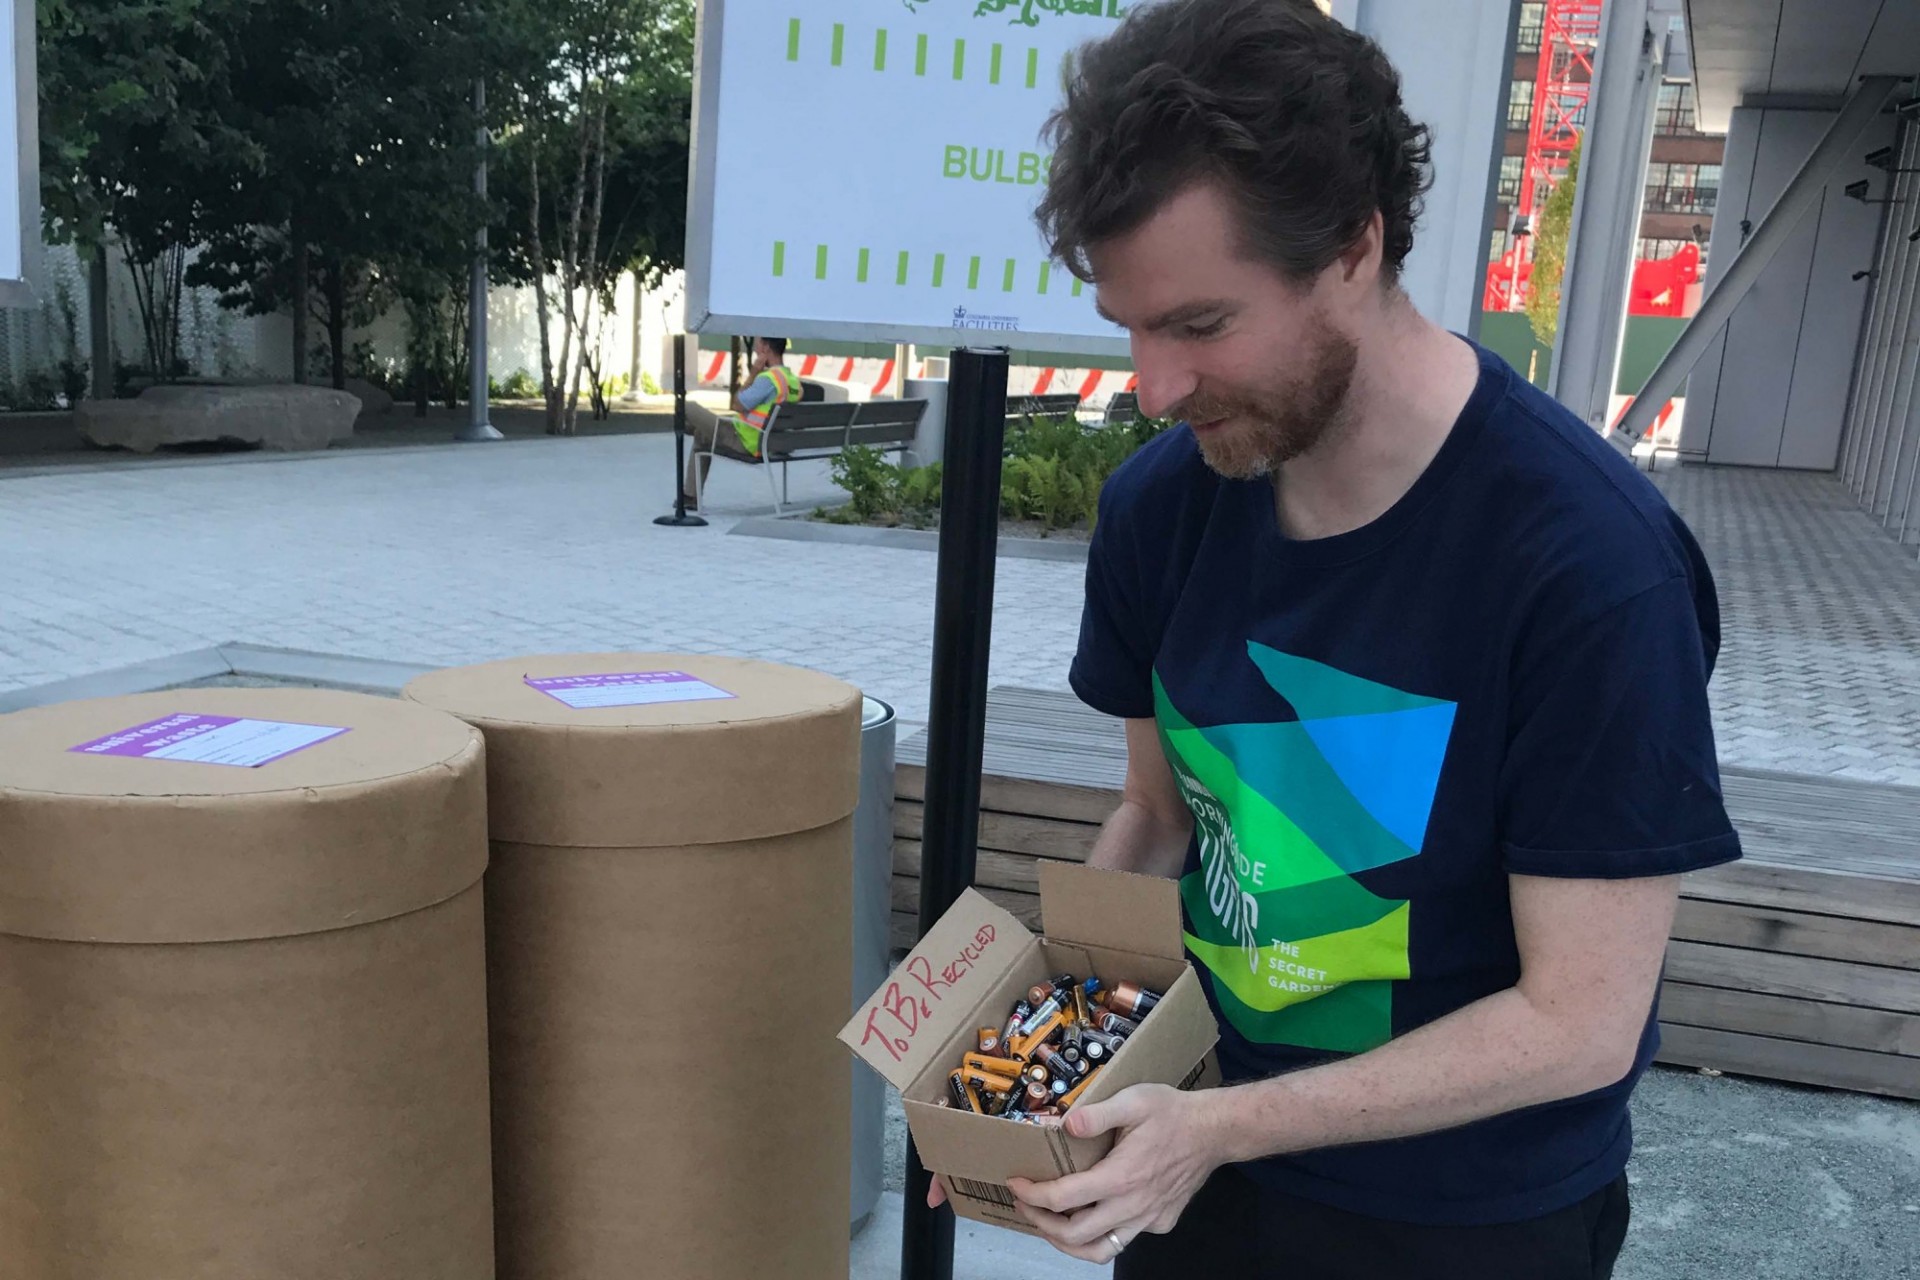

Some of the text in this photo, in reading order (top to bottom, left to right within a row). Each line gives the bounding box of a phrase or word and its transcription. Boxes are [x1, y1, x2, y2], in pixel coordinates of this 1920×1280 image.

[84, 714, 200, 752] universal
[142, 723, 217, 747] waste
[1271, 938, 1300, 958] THE
[1268, 957, 1327, 981] SECRET
